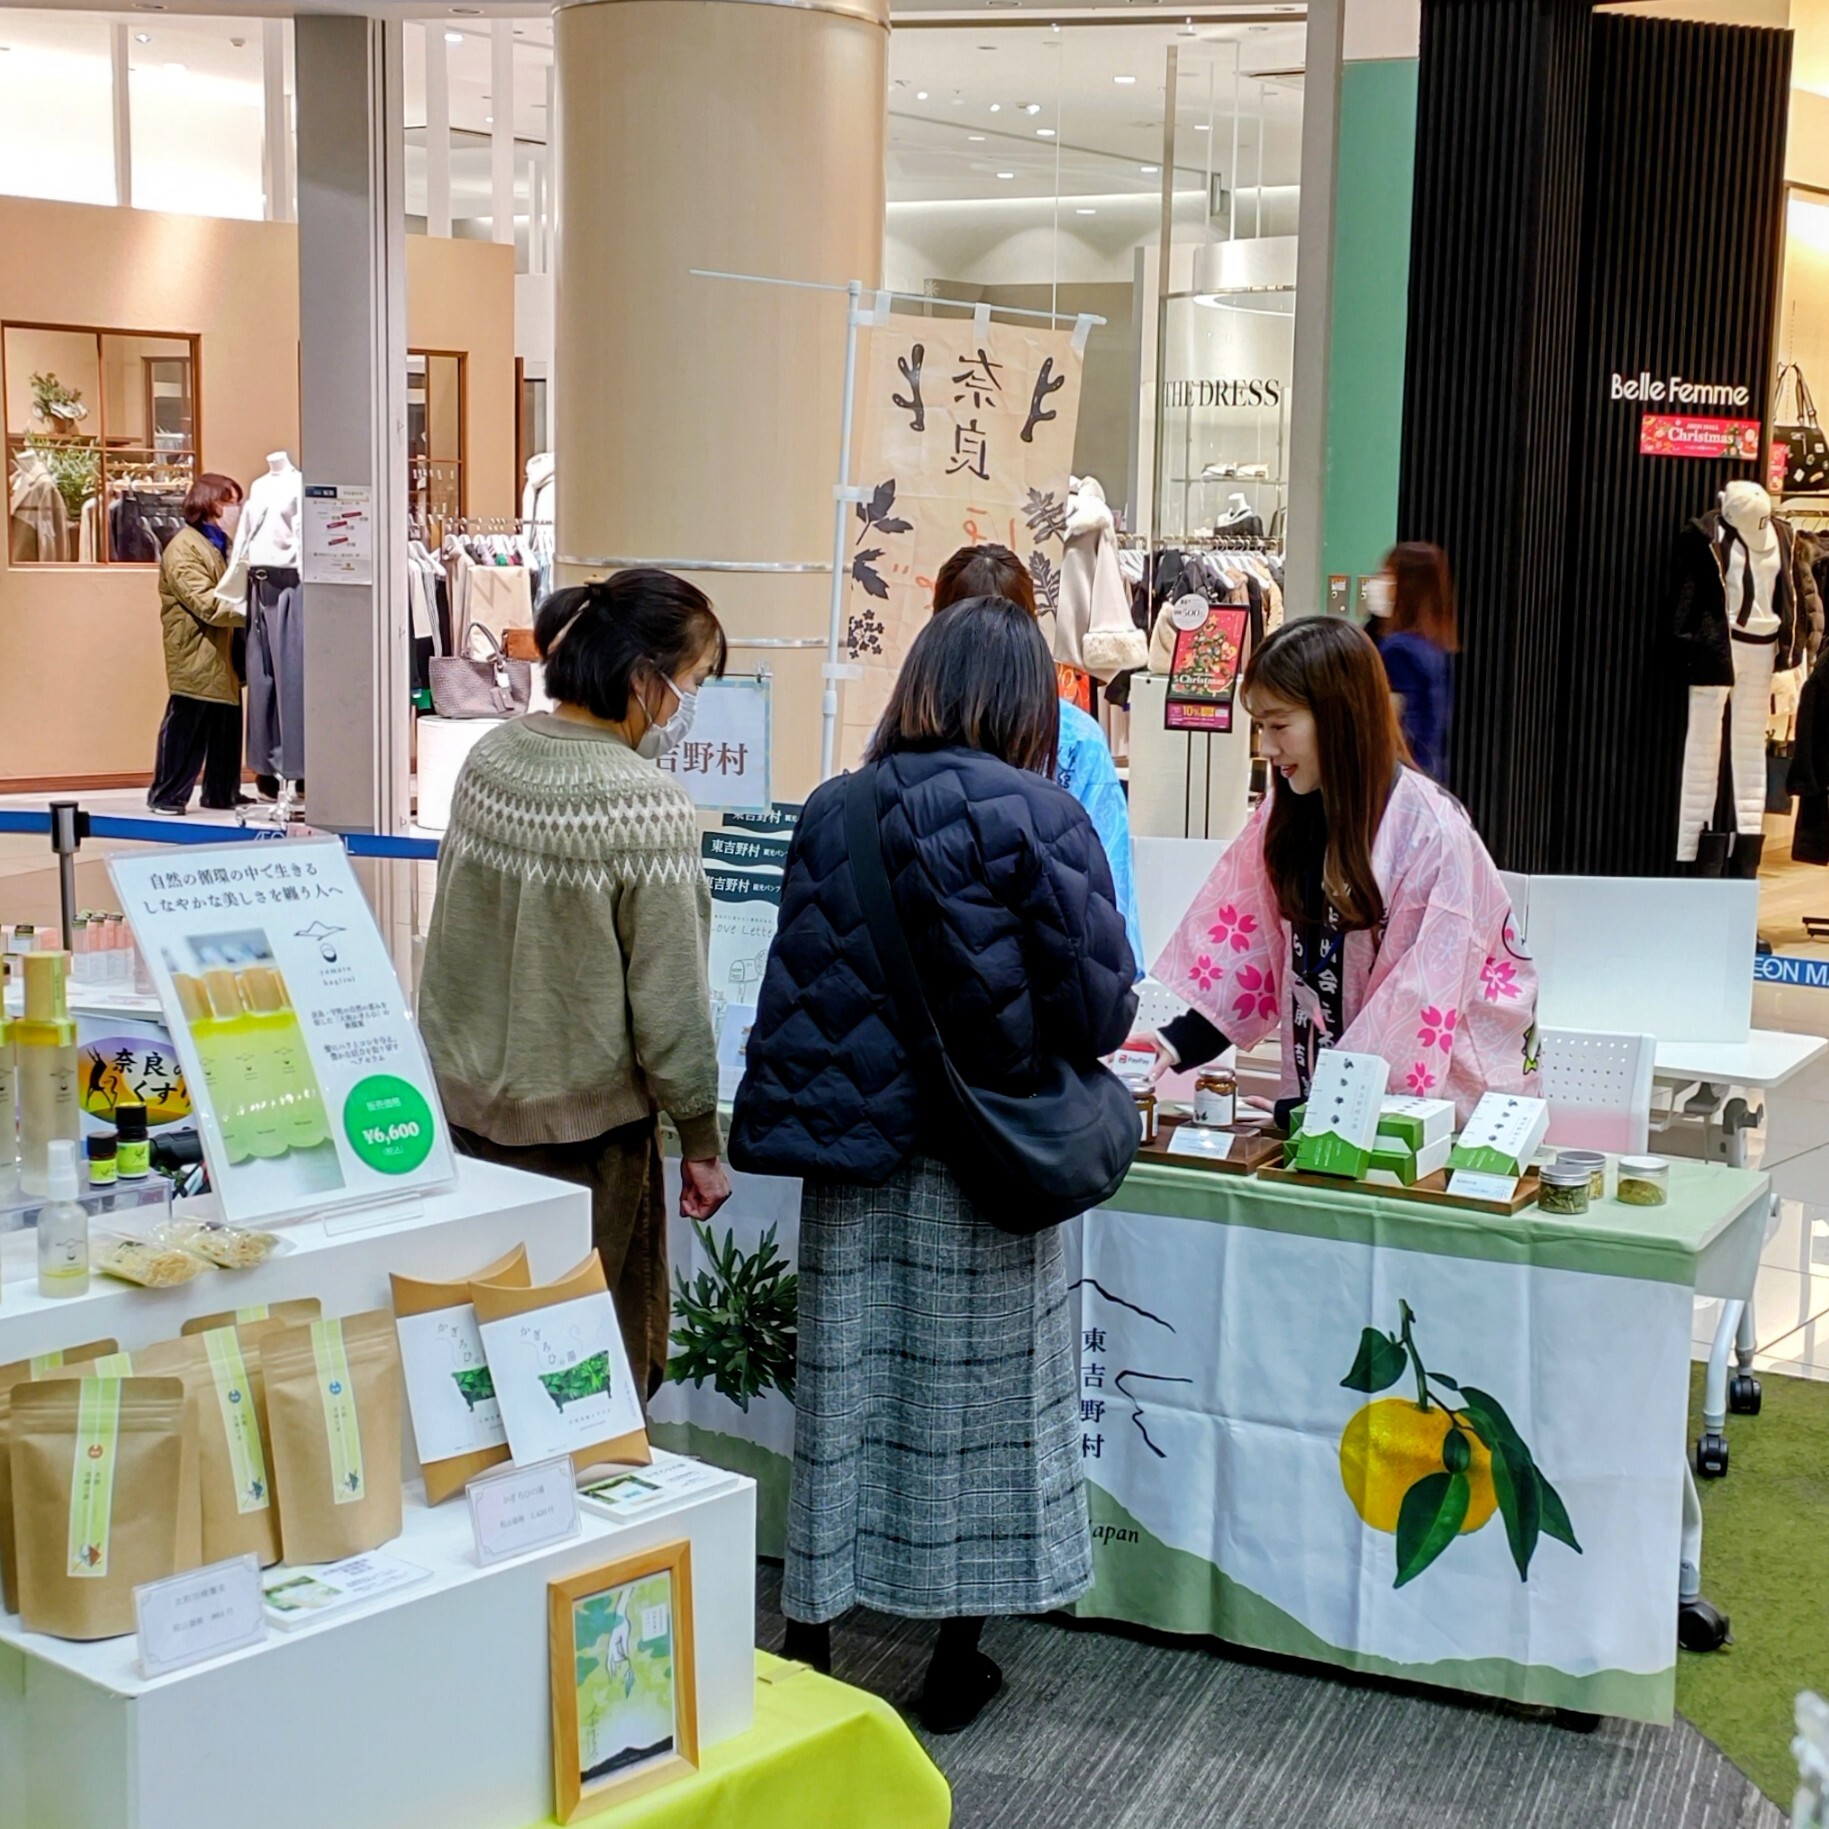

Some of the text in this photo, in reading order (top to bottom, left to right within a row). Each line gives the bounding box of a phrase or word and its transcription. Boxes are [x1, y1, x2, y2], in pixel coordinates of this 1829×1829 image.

[1163, 378, 1280, 408] THE DRESS
[1610, 371, 1750, 406] Belle Femme
[1667, 426, 1735, 445] Christmas
[711, 838, 788, 858] 東吉野村 観光パン
[149, 861, 319, 891] 自然の循環の中で生きる
[142, 882, 345, 916] しなやかな美しさを纏う人へ
[712, 923, 737, 937] ove
[1753, 957, 1829, 986] EON M
[362, 1120, 420, 1146] ¥6,600
[1080, 1327, 1107, 1459] 東吉野村
[1089, 1519, 1139, 1546] apan
